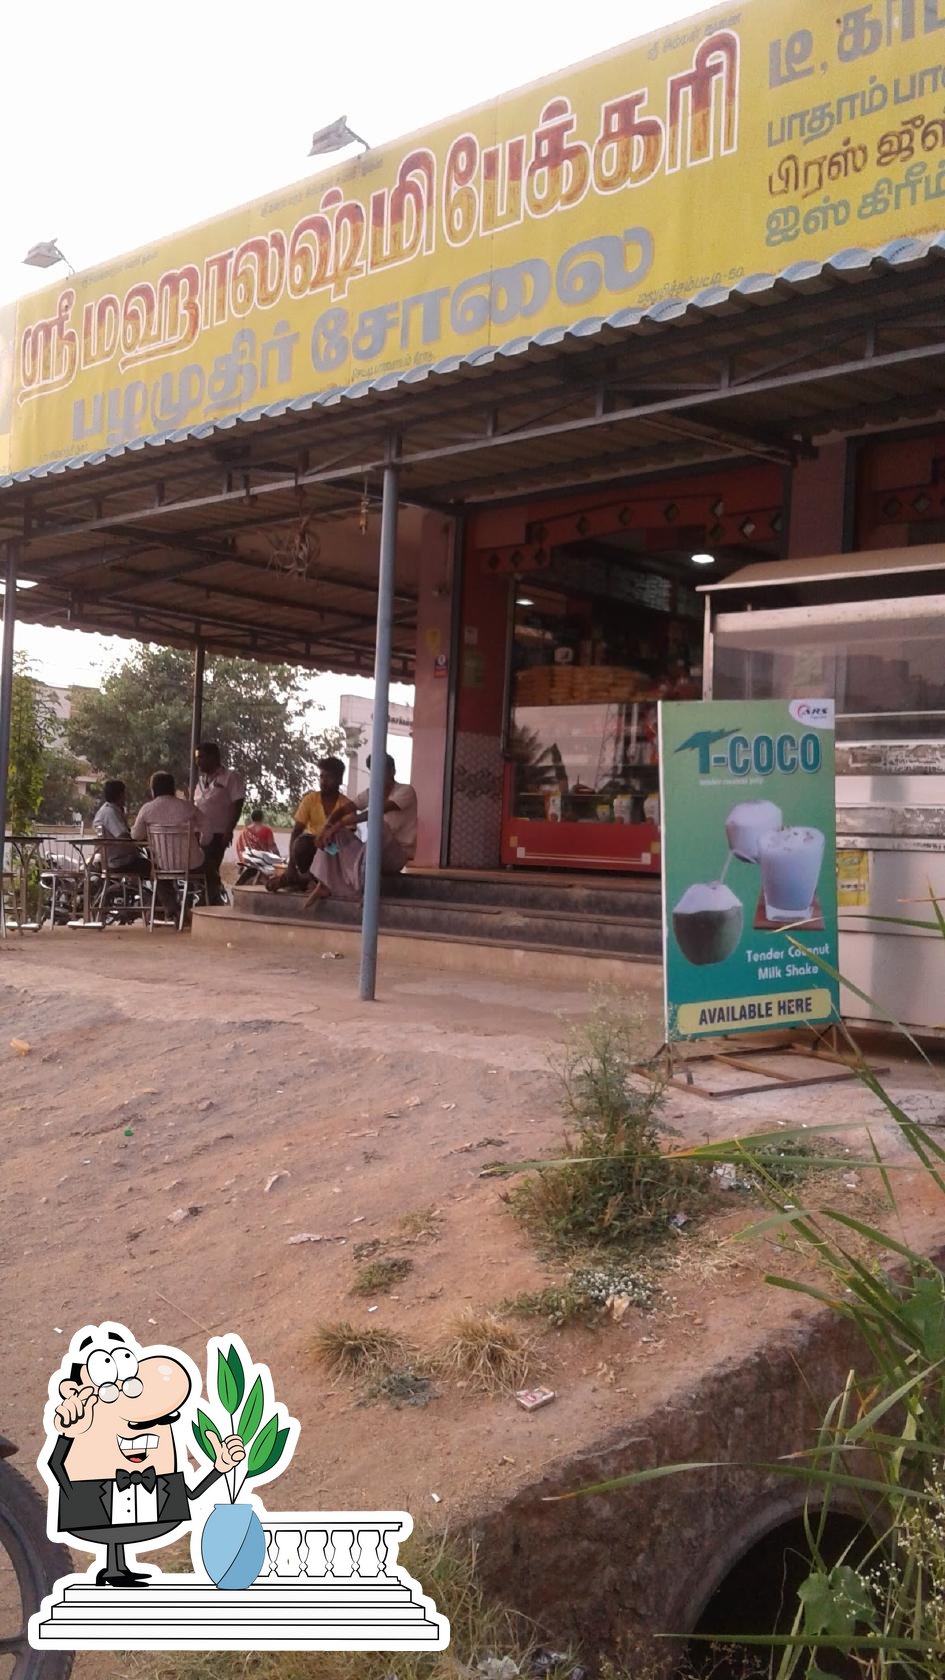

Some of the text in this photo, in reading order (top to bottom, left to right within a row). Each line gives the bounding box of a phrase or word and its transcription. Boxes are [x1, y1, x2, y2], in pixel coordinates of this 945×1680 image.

[769, 137, 868, 199] பிரஸ்
[746, 948, 784, 962] Tender
[758, 962, 818, 980] Milk Shake
[699, 997, 812, 1025] AVAILABLE HERE
